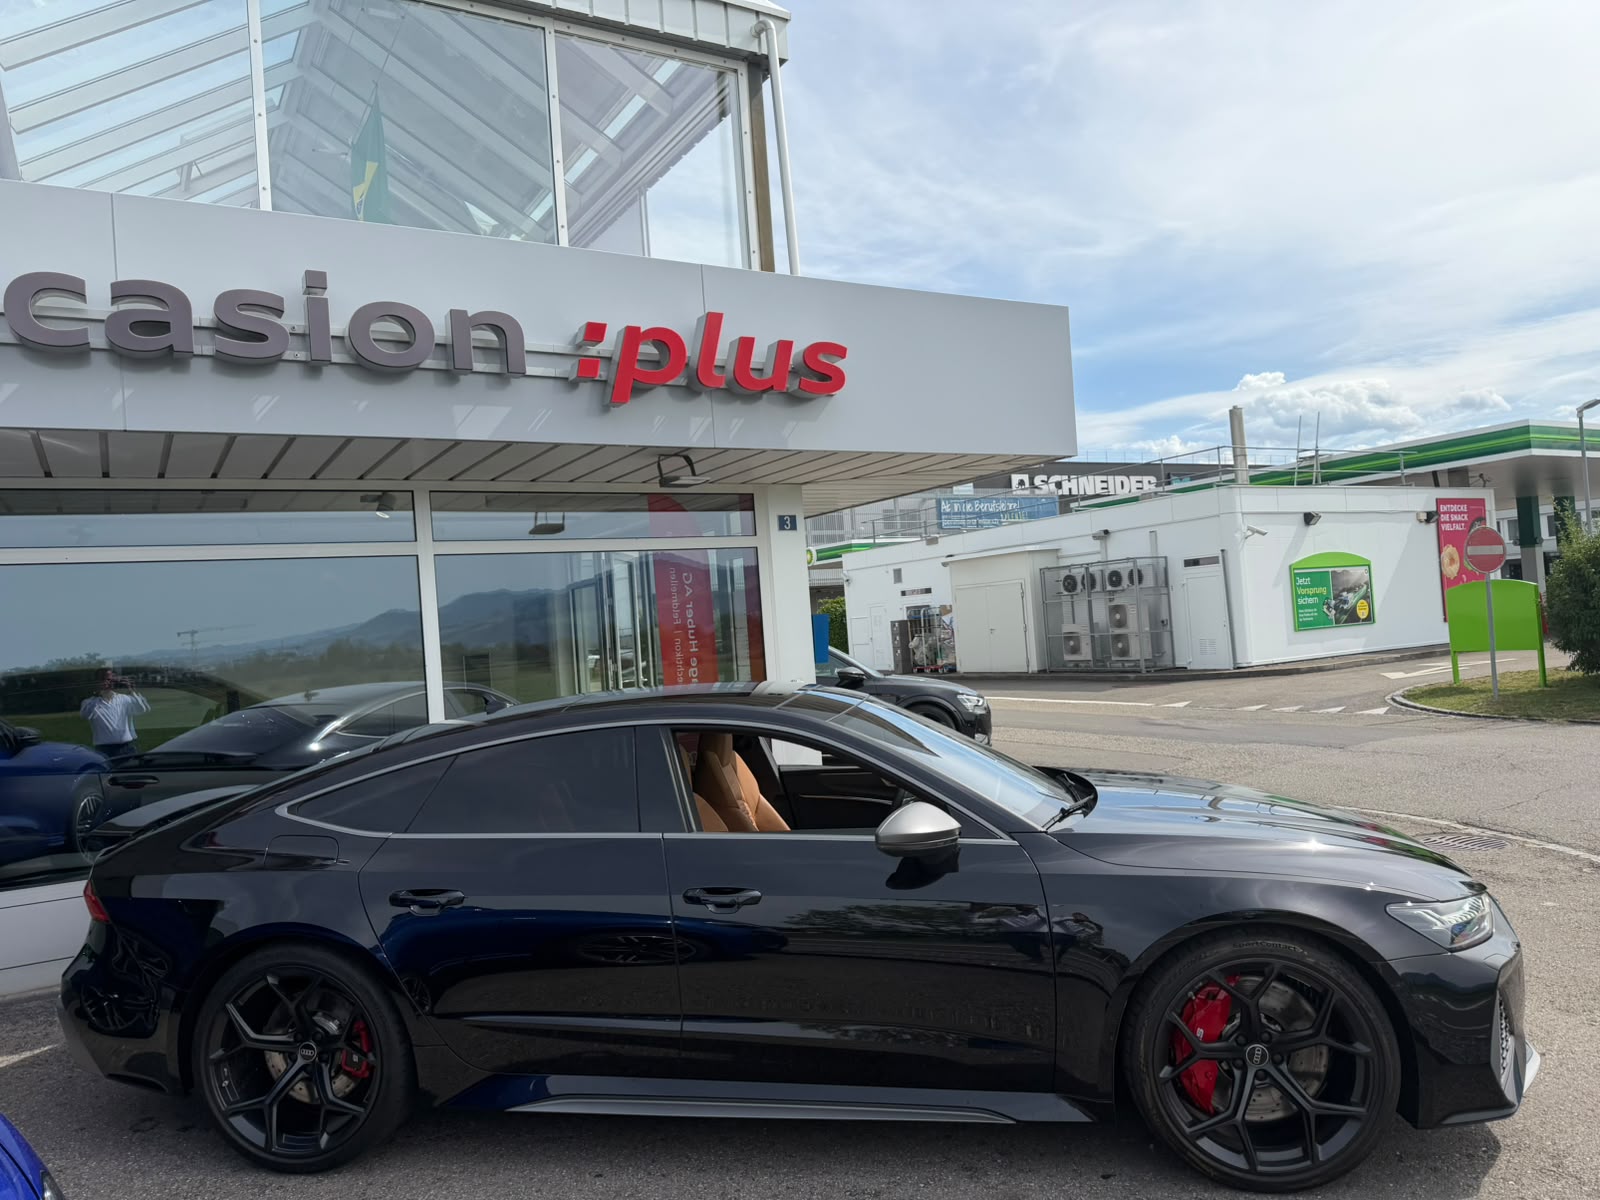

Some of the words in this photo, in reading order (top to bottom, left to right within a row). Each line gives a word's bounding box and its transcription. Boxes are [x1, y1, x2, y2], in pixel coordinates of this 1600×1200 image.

[1033, 474, 1158, 496] SCHNEIDER
[1440, 504, 1468, 512] ENTDECKE
[1440, 513, 1450, 521] DIE
[1450, 513, 1469, 521] SNACK
[783, 515, 791, 530] 3
[1296, 577, 1311, 585] Jetzt
[1297, 586, 1327, 596] Vorsprung
[1297, 596, 1319, 605] sichern
